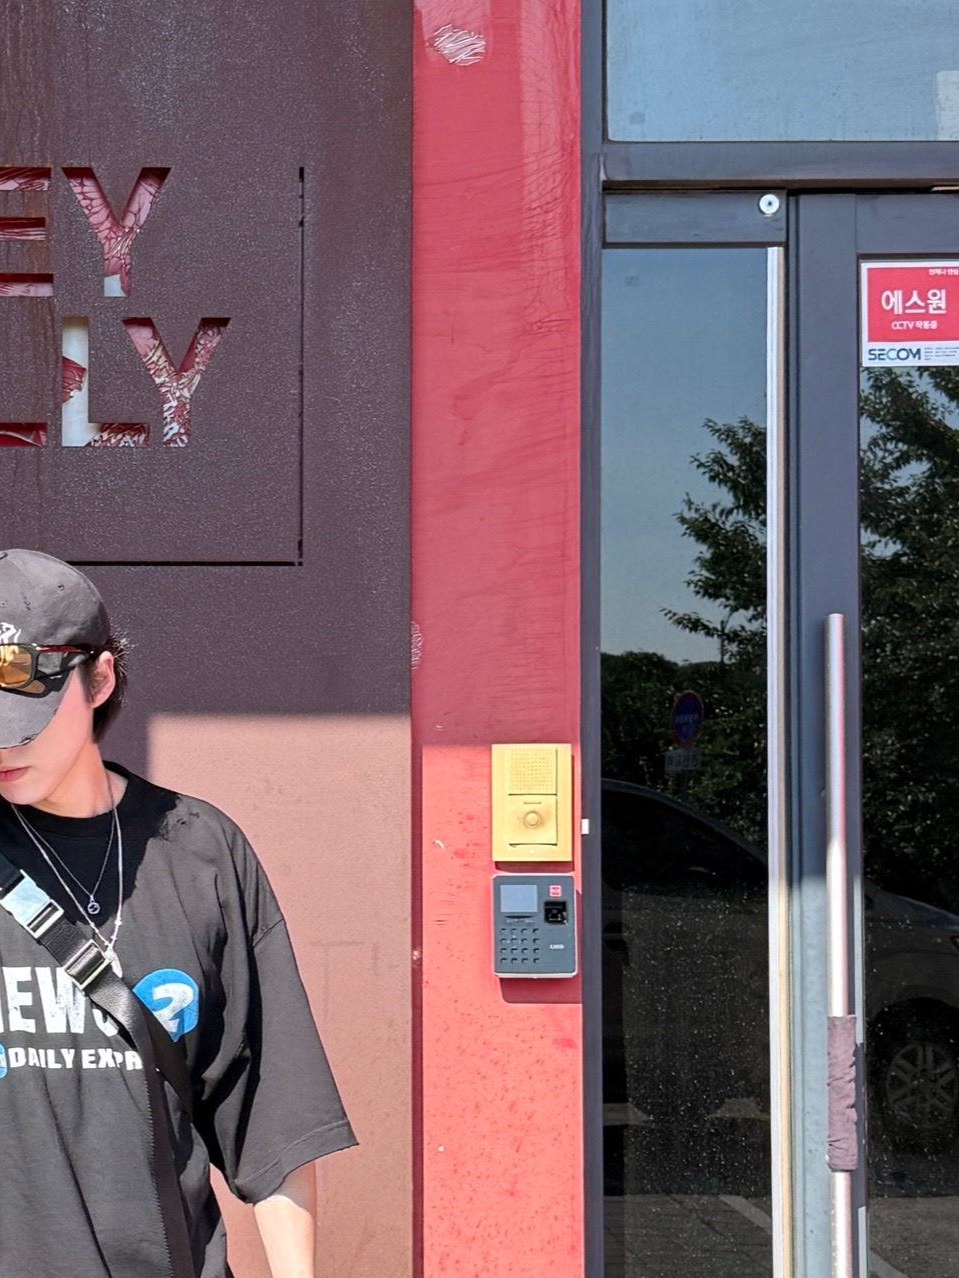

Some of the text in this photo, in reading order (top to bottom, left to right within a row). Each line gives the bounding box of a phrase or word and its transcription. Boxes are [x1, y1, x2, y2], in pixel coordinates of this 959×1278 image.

[881, 288, 947, 315] 에스원
[891, 320, 914, 330] CCTV
[868, 348, 921, 361] SECOM
[10, 1047, 76, 1069] DAILY
